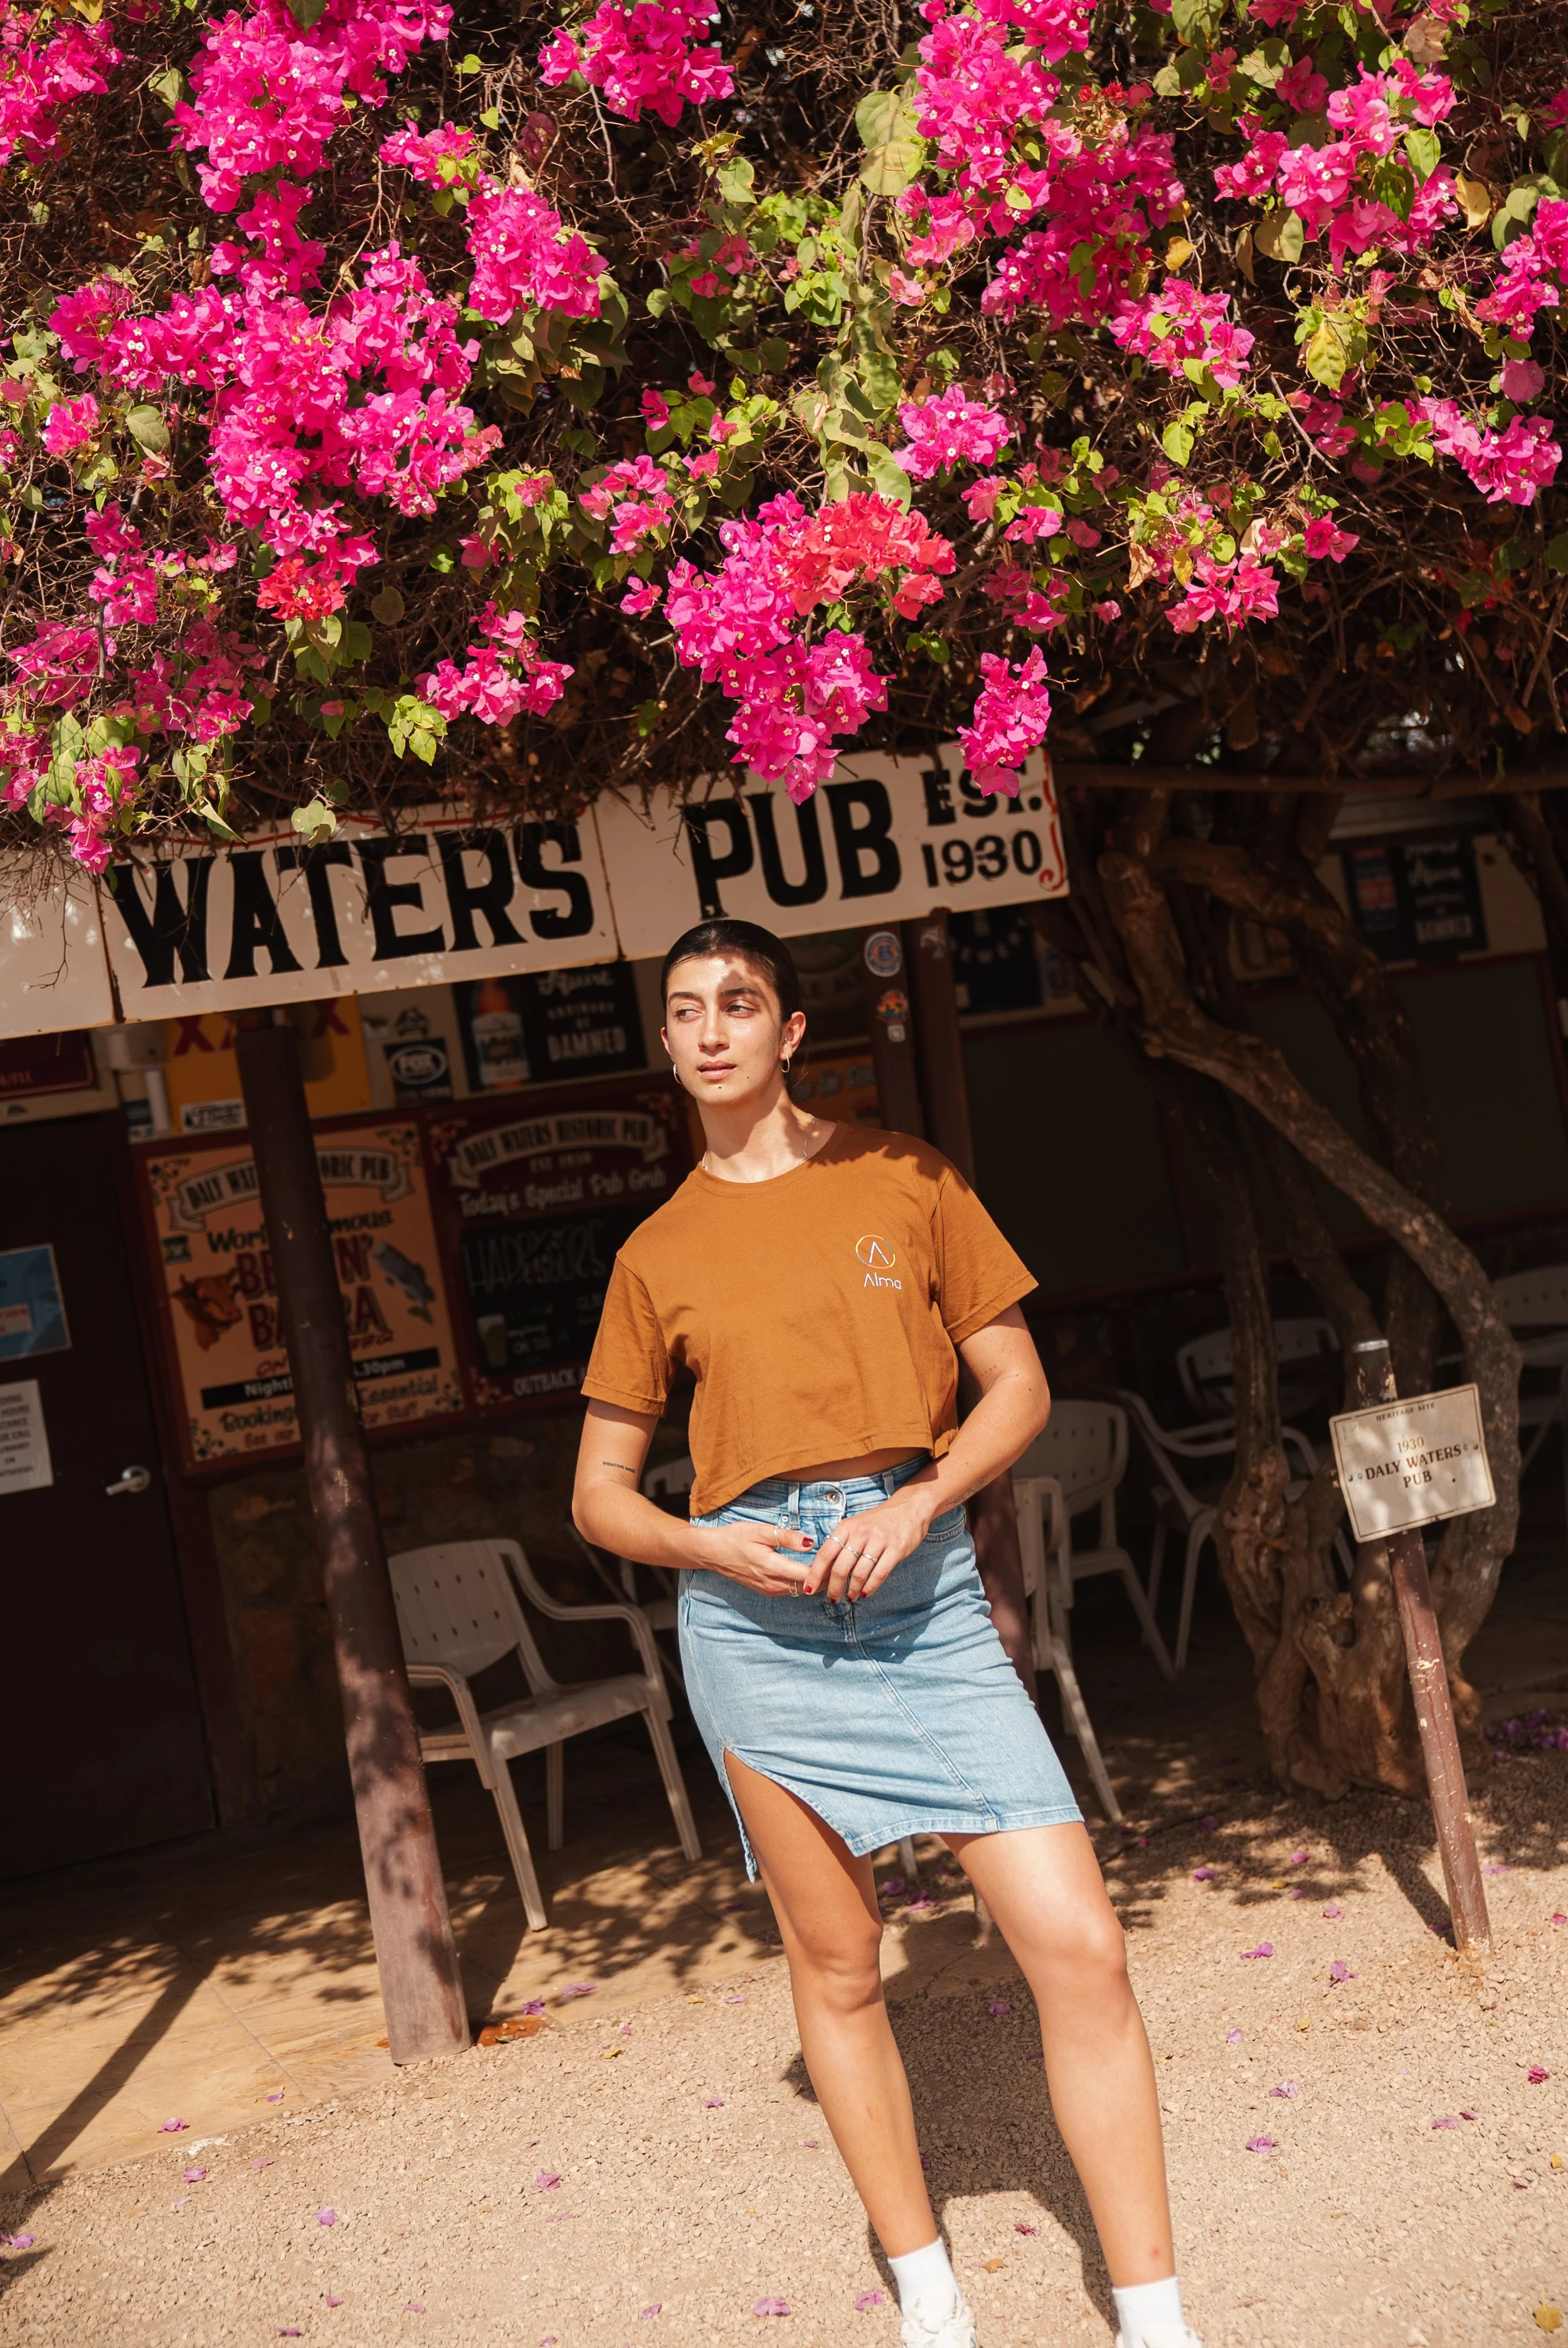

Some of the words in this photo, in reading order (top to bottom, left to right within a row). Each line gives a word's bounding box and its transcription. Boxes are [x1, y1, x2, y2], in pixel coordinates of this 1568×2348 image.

[921, 830, 1042, 888] 1930
[107, 817, 594, 988] WATERS
[679, 780, 902, 920] PUB
[458, 1185, 521, 1218] Today's
[524, 1176, 585, 1211] Special
[589, 1169, 625, 1198] Pub
[863, 1272, 902, 1290] Alma
[1375, 1408, 1414, 1422] HERITAGE
[1417, 1403, 1436, 1413] SITE
[1396, 1437, 1425, 1454] 1930
[1365, 1460, 1401, 1480] DALY
[1406, 1444, 1462, 1469] WATERS
[1402, 1470, 1433, 1489] PUB
